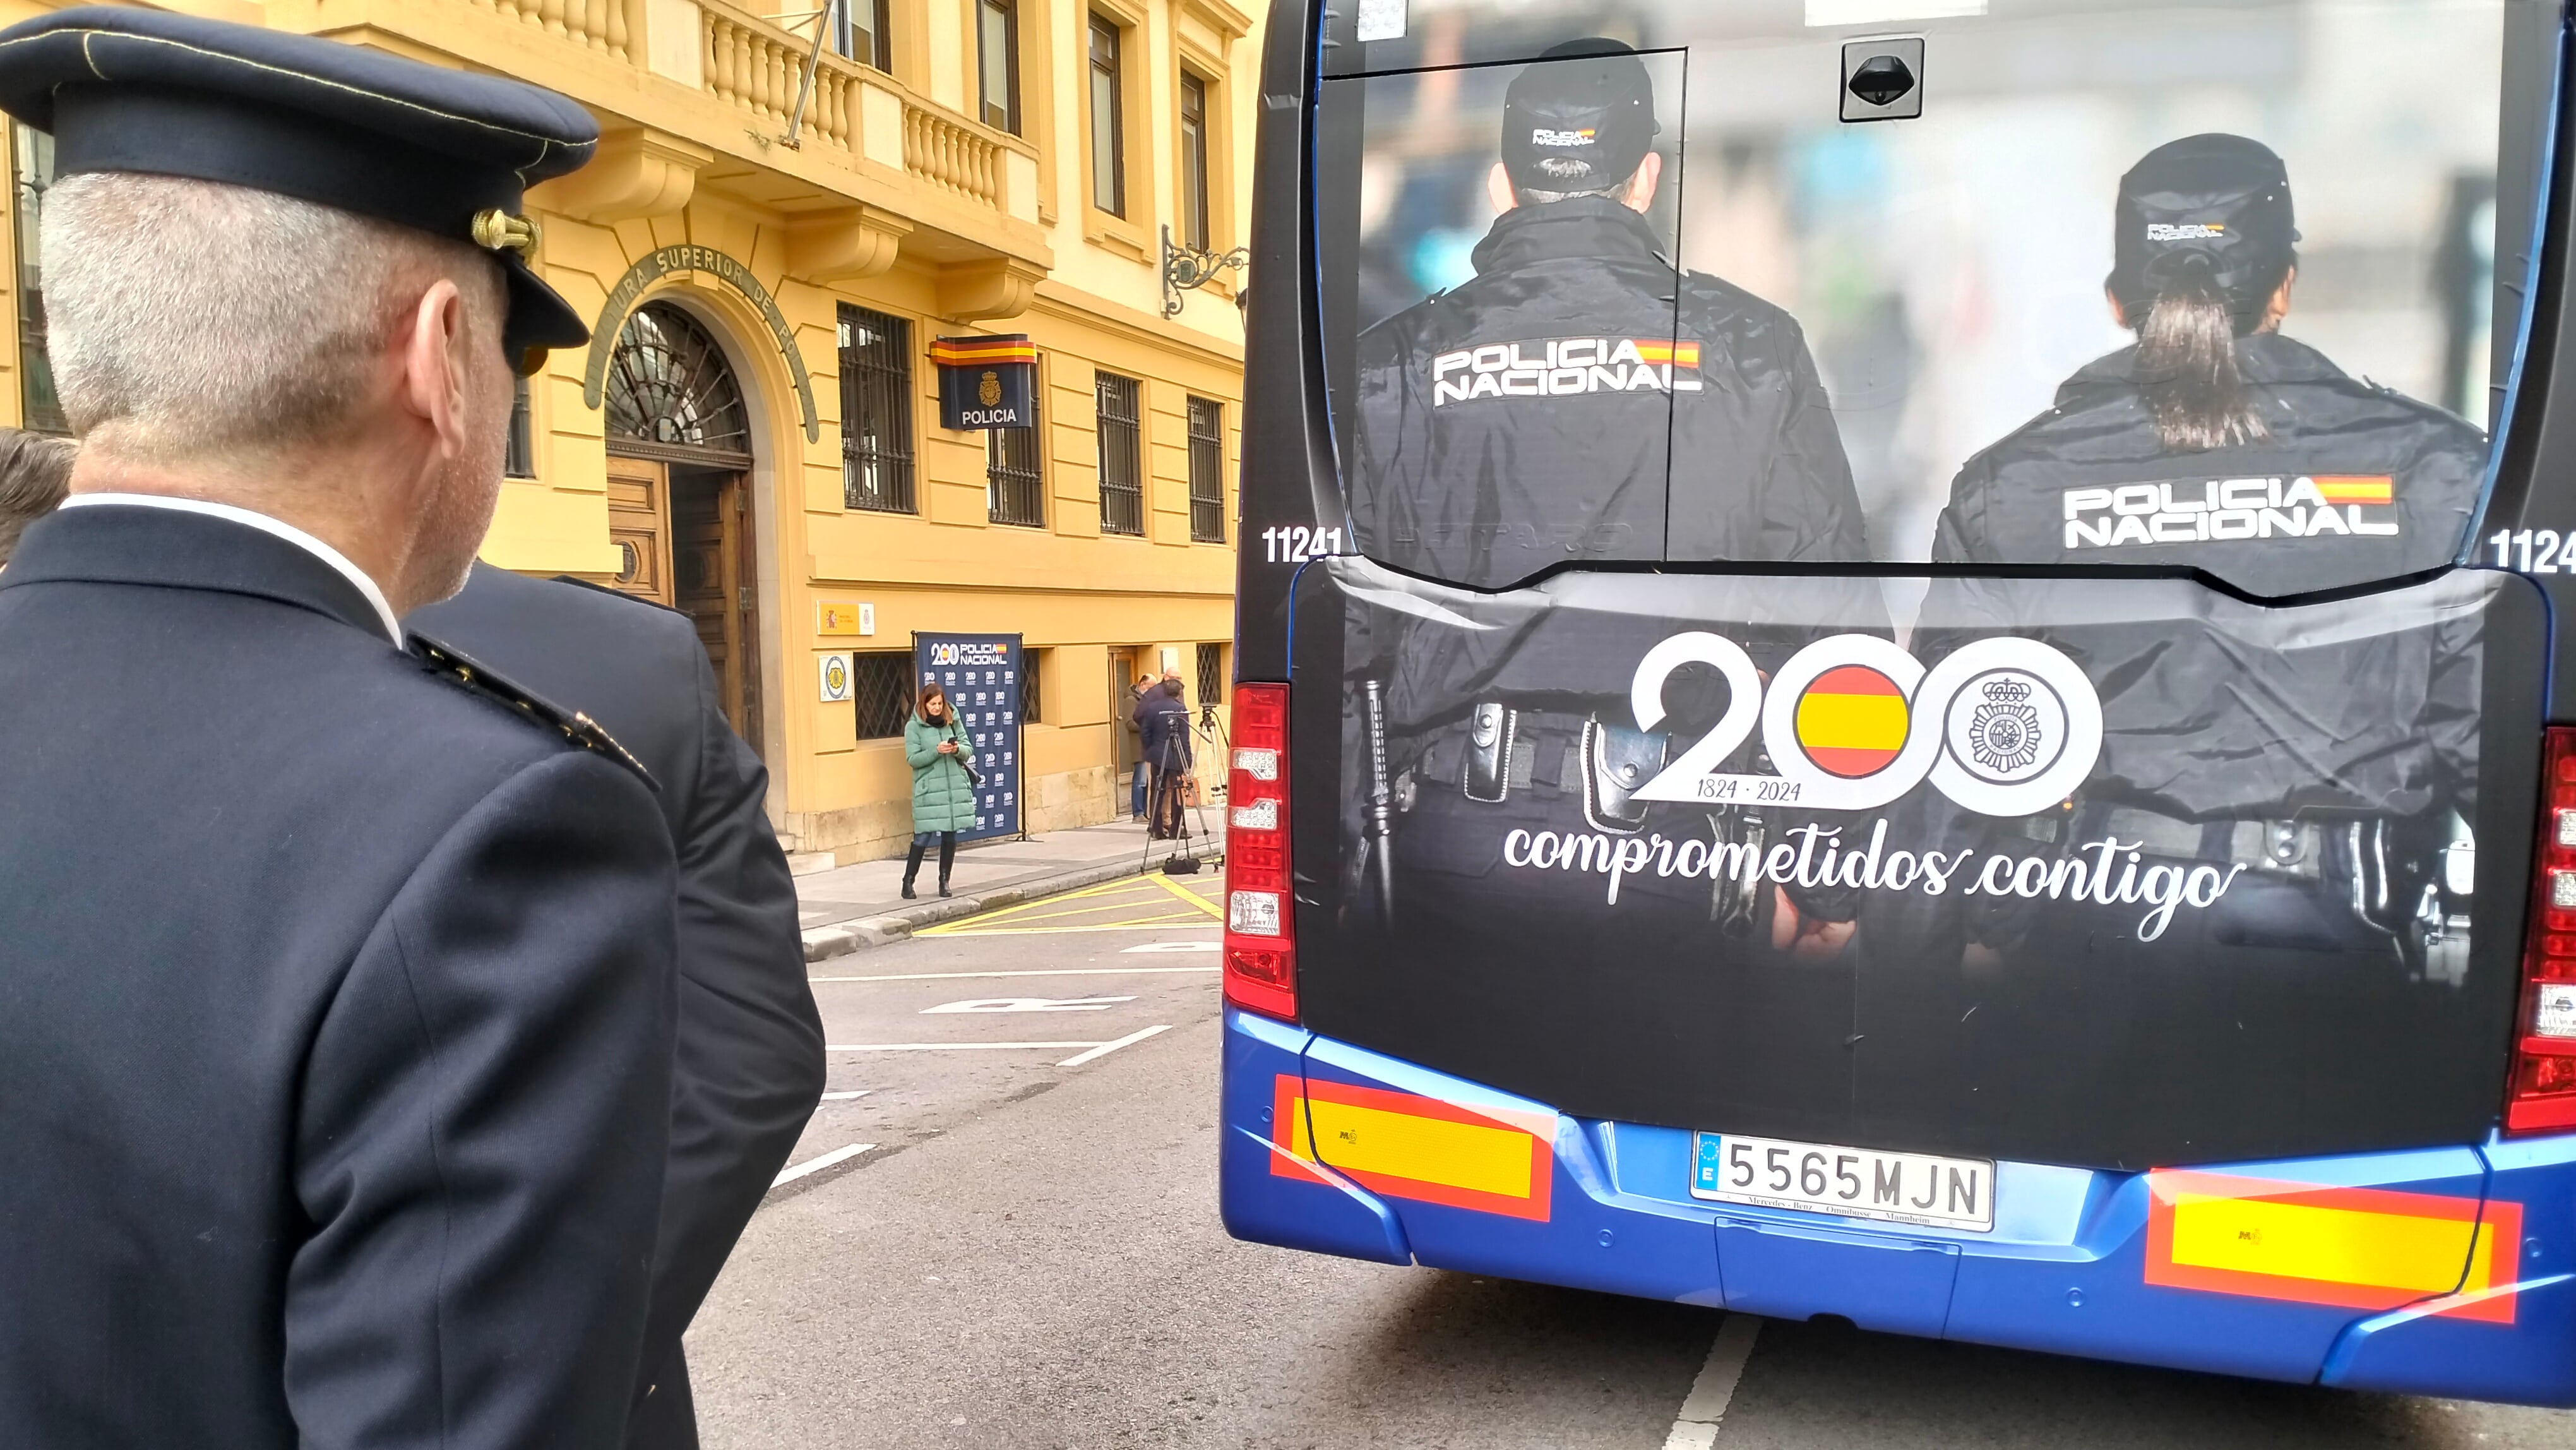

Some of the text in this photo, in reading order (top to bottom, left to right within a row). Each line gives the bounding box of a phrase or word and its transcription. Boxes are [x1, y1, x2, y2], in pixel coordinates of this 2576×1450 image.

[656, 247, 744, 286] SUPERIOR
[753, 287, 773, 314] DE
[1433, 339, 1645, 381] POLICIA
[1434, 364, 1703, 406] NACIONAL
[962, 409, 1017, 425] POLICIA
[2064, 477, 2329, 520] POLICIA
[1262, 526, 1342, 563] 11241
[2065, 505, 2399, 548] NACIONAL
[931, 643, 998, 665] 200 POLICIA
[960, 654, 1007, 665] NACIONAL
[1630, 631, 2103, 817] 200
[1697, 779, 1738, 798] 1824
[1756, 781, 1801, 801] 2024
[1504, 818, 2247, 942] comprometidos contigo
[1702, 1168, 1713, 1181] E
[1731, 1144, 1976, 1214] 5565MJN
[1748, 1197, 1786, 1207] Mercedes
[1793, 1202, 1813, 1210] Benz
[1885, 1213, 1930, 1225] Mannheim
